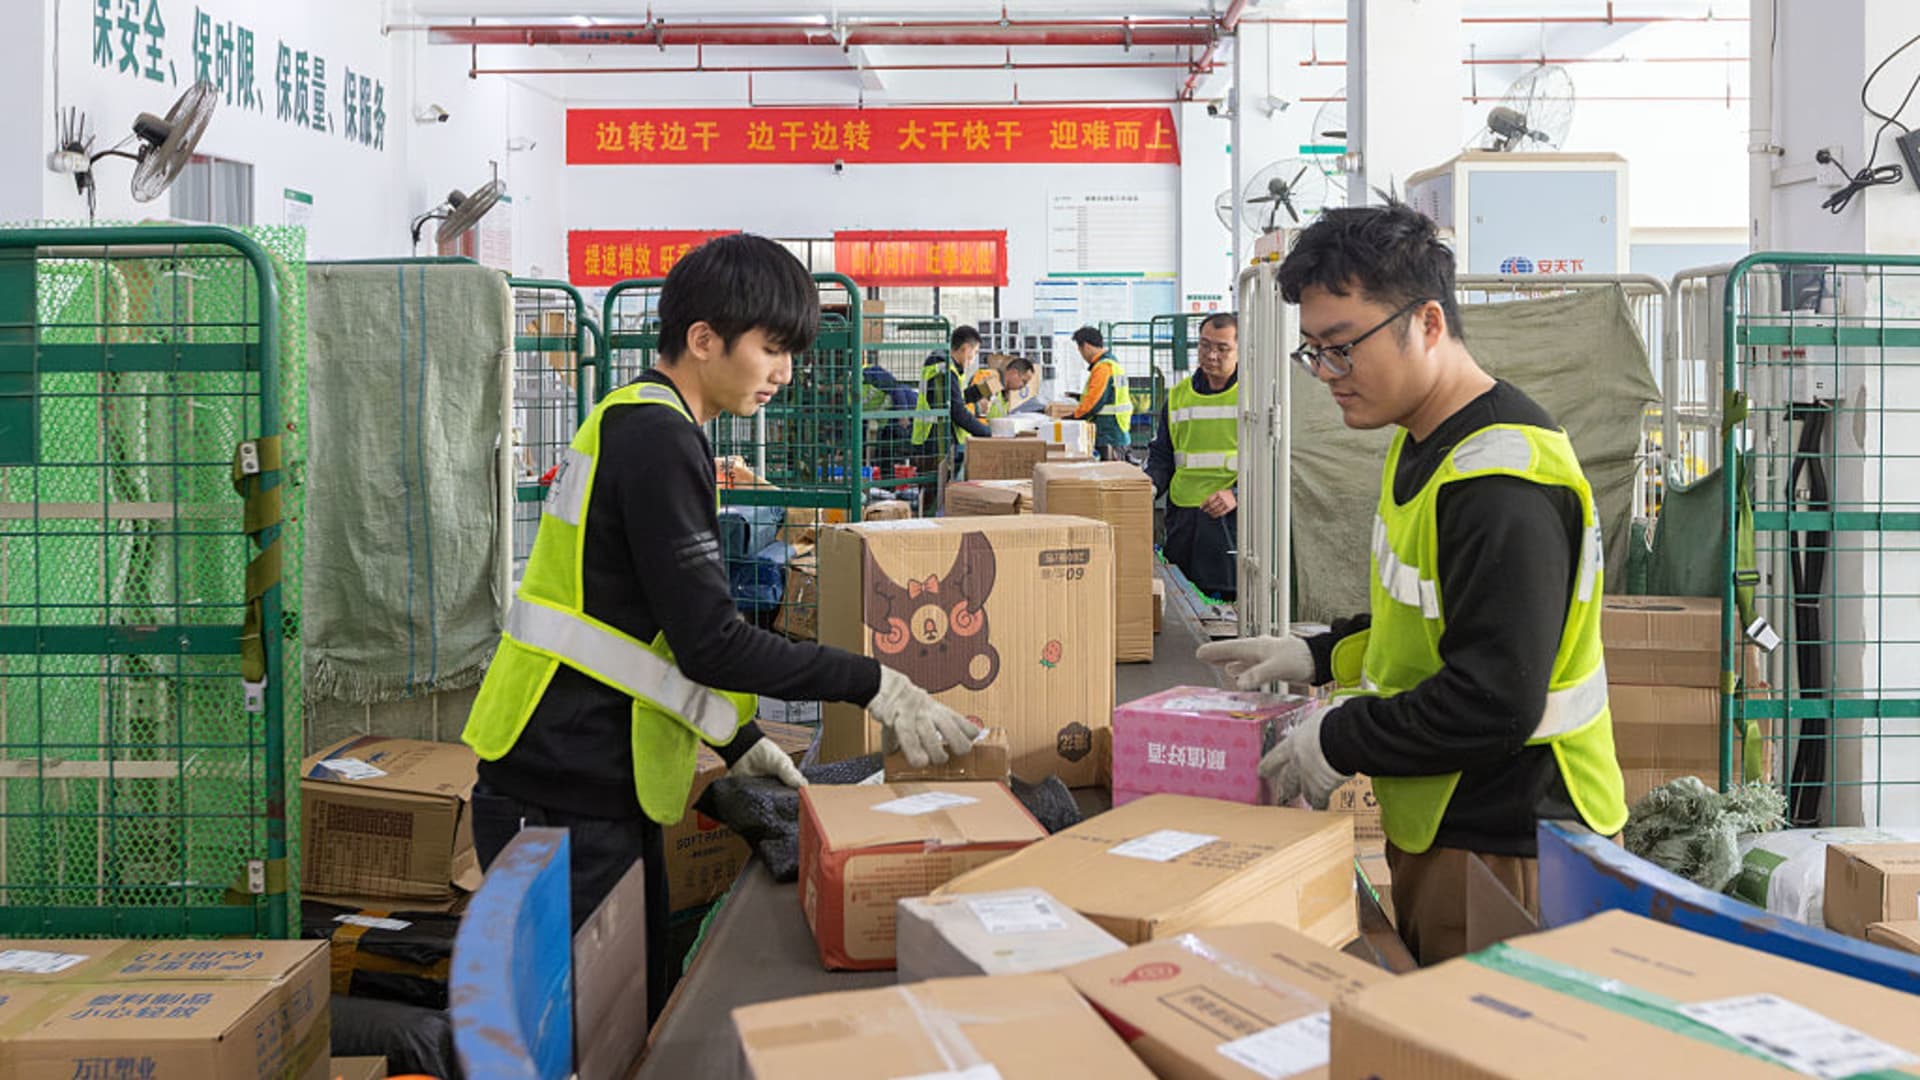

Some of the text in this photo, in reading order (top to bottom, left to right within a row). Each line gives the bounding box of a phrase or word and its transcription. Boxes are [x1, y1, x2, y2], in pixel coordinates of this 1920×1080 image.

[596, 119, 1172, 152] 边转边干 边干边转 大干快干 迎难而上
[584, 244, 651, 277] 提速增效
[1537, 258, 1585, 273] 安天下
[87, 992, 214, 1006] 塑料制品
[68, 1006, 200, 1020] 小心轻放
